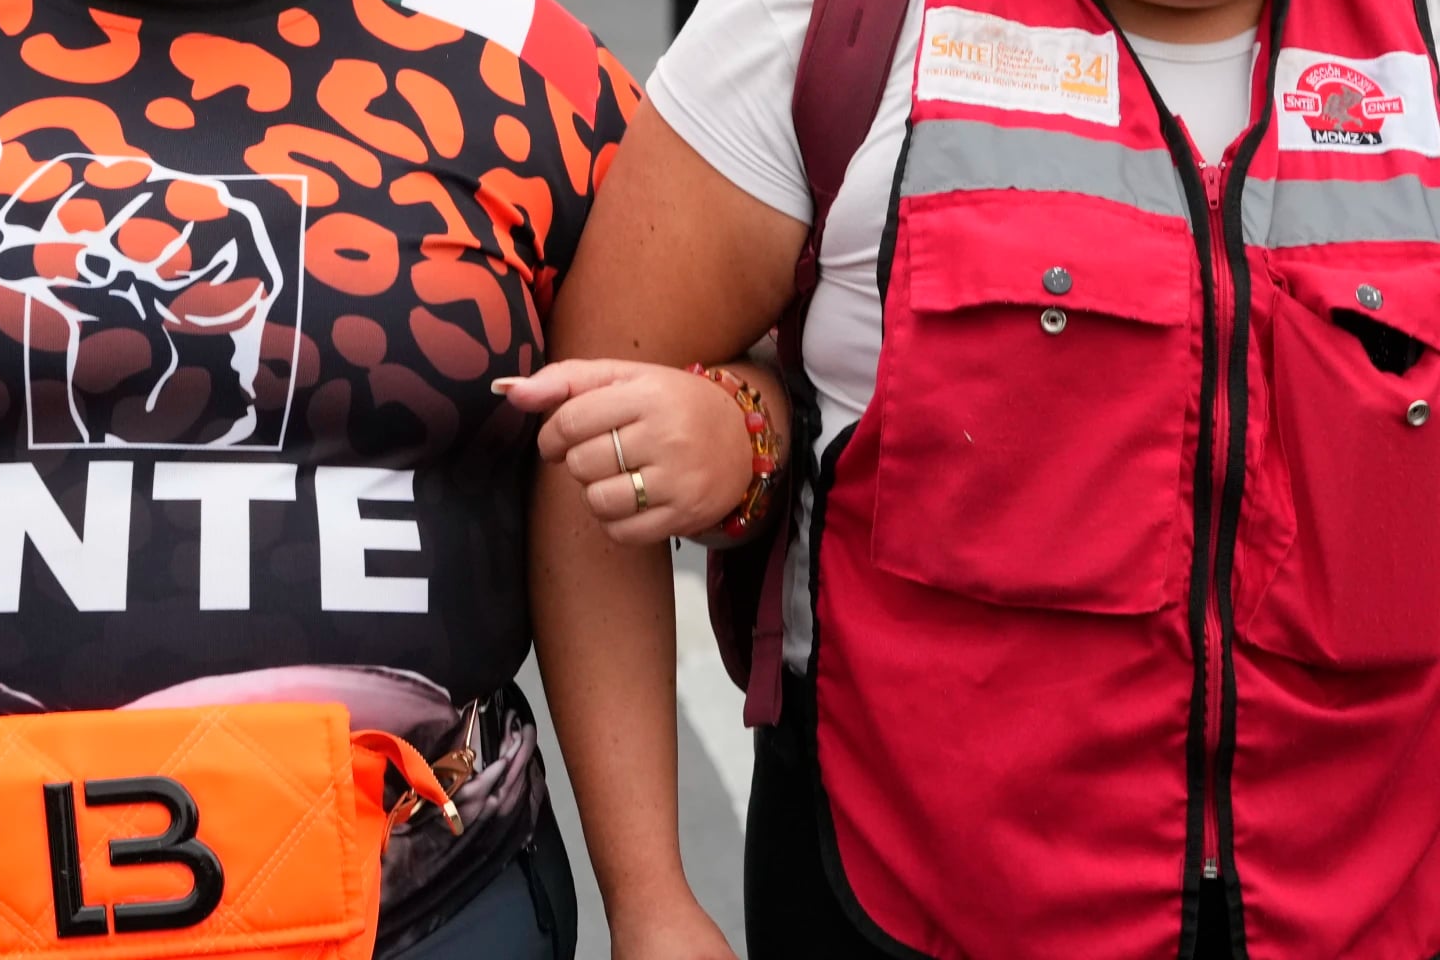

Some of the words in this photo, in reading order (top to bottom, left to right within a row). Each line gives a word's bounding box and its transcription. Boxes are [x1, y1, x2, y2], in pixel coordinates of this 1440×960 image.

[930, 33, 988, 63] SNTE
[1064, 53, 1107, 83] 34
[1286, 95, 1315, 111] SNTE
[1315, 129, 1360, 145] MDMZ
